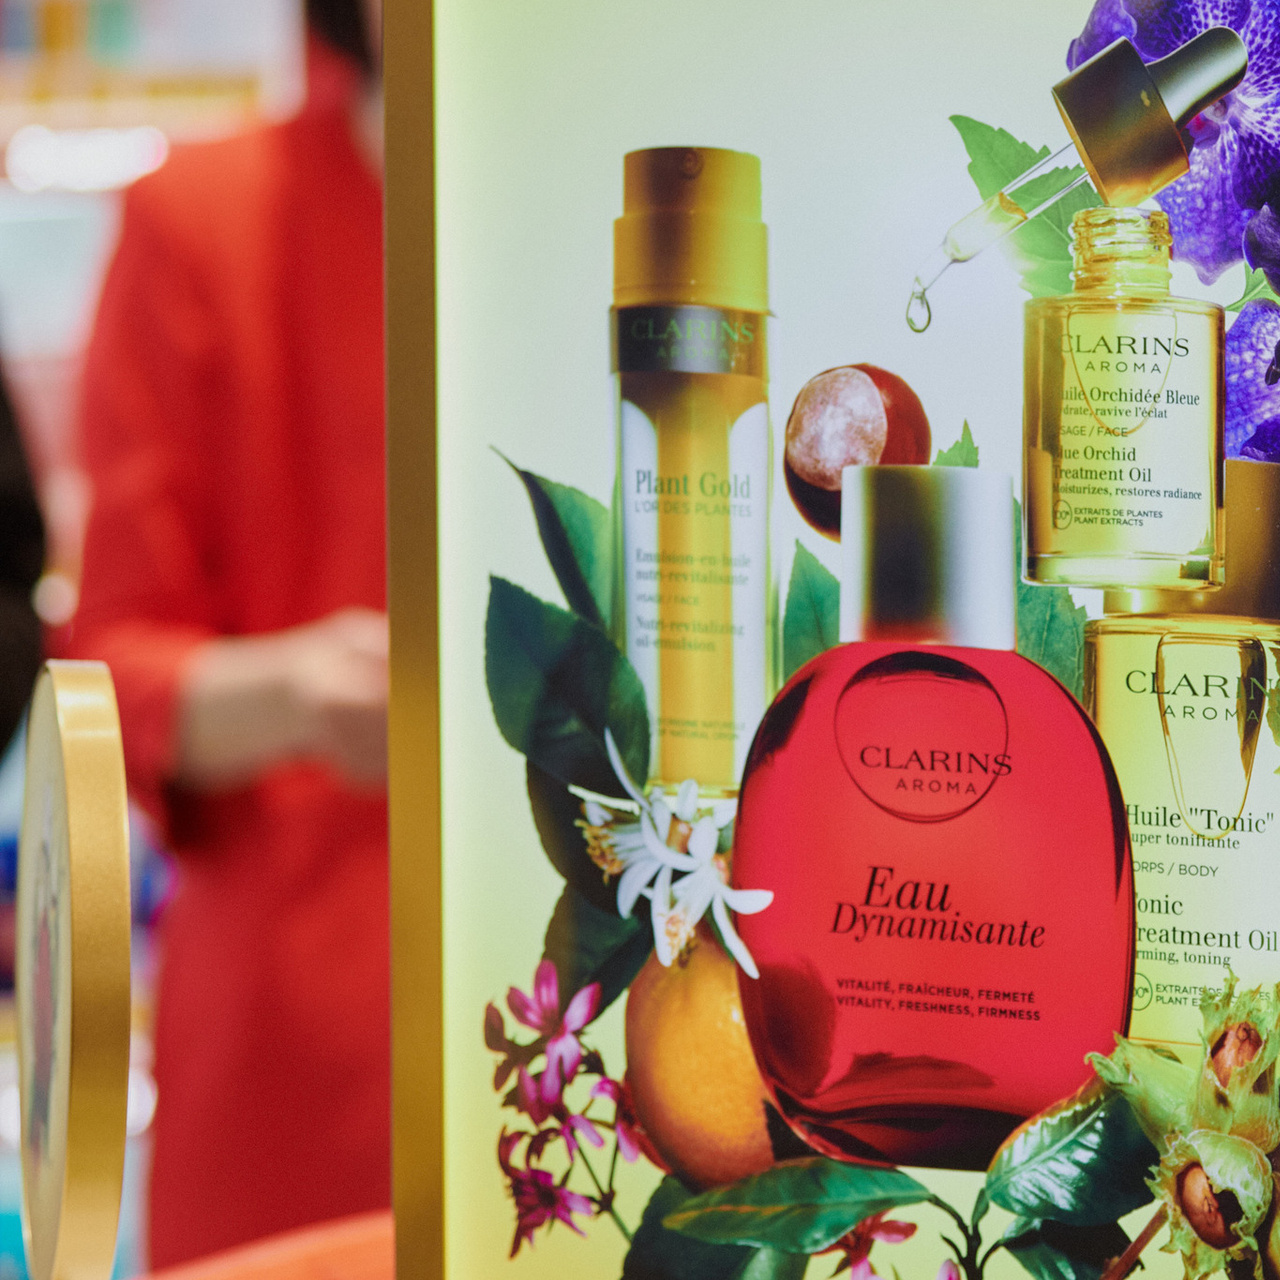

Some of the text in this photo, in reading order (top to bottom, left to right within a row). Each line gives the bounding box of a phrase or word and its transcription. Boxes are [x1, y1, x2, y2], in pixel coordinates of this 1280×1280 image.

[630, 320, 756, 345] CLARINS
[1085, 361, 1162, 374] AROMA
[1062, 386, 1200, 406] uile Orchidée Bleue
[1062, 404, 1092, 417] drate,
[1095, 407, 1132, 417] ravive
[1060, 425, 1087, 436] SAGE
[1097, 427, 1129, 438] FACE
[1083, 445, 1137, 462] Orchid
[1054, 464, 1152, 483] Treatment Oil
[635, 469, 751, 499] Plant Gold
[1115, 487, 1161, 498] restores
[1163, 489, 1202, 500] radiance
[1074, 507, 1163, 519] EXTRAITS DE PLANTES
[1074, 517, 1144, 527] PLANT EXTRACTS
[1162, 706, 1260, 722] AROMA
[859, 745, 1013, 777] CLARINS
[895, 778, 978, 796] AROMA
[1126, 803, 1275, 834] Huile "Tonic"
[1131, 832, 1241, 850] uper tonifiante
[1133, 860, 1165, 874] ORPS
[1179, 864, 1219, 878] BODY
[859, 865, 953, 913] Eau
[1137, 893, 1184, 917] onic
[830, 902, 1046, 949] Dynamisante
[1137, 922, 1279, 952] reatment Oil
[1136, 949, 1232, 969] rming, toning
[836, 977, 1036, 1005] VITALITÉ, FRAÎCHEUR, FERMETÉ
[836, 996, 1041, 1022] VITALITY, FRESHNESS, FIRMNESS
[1155, 995, 1188, 1007] PLANT
